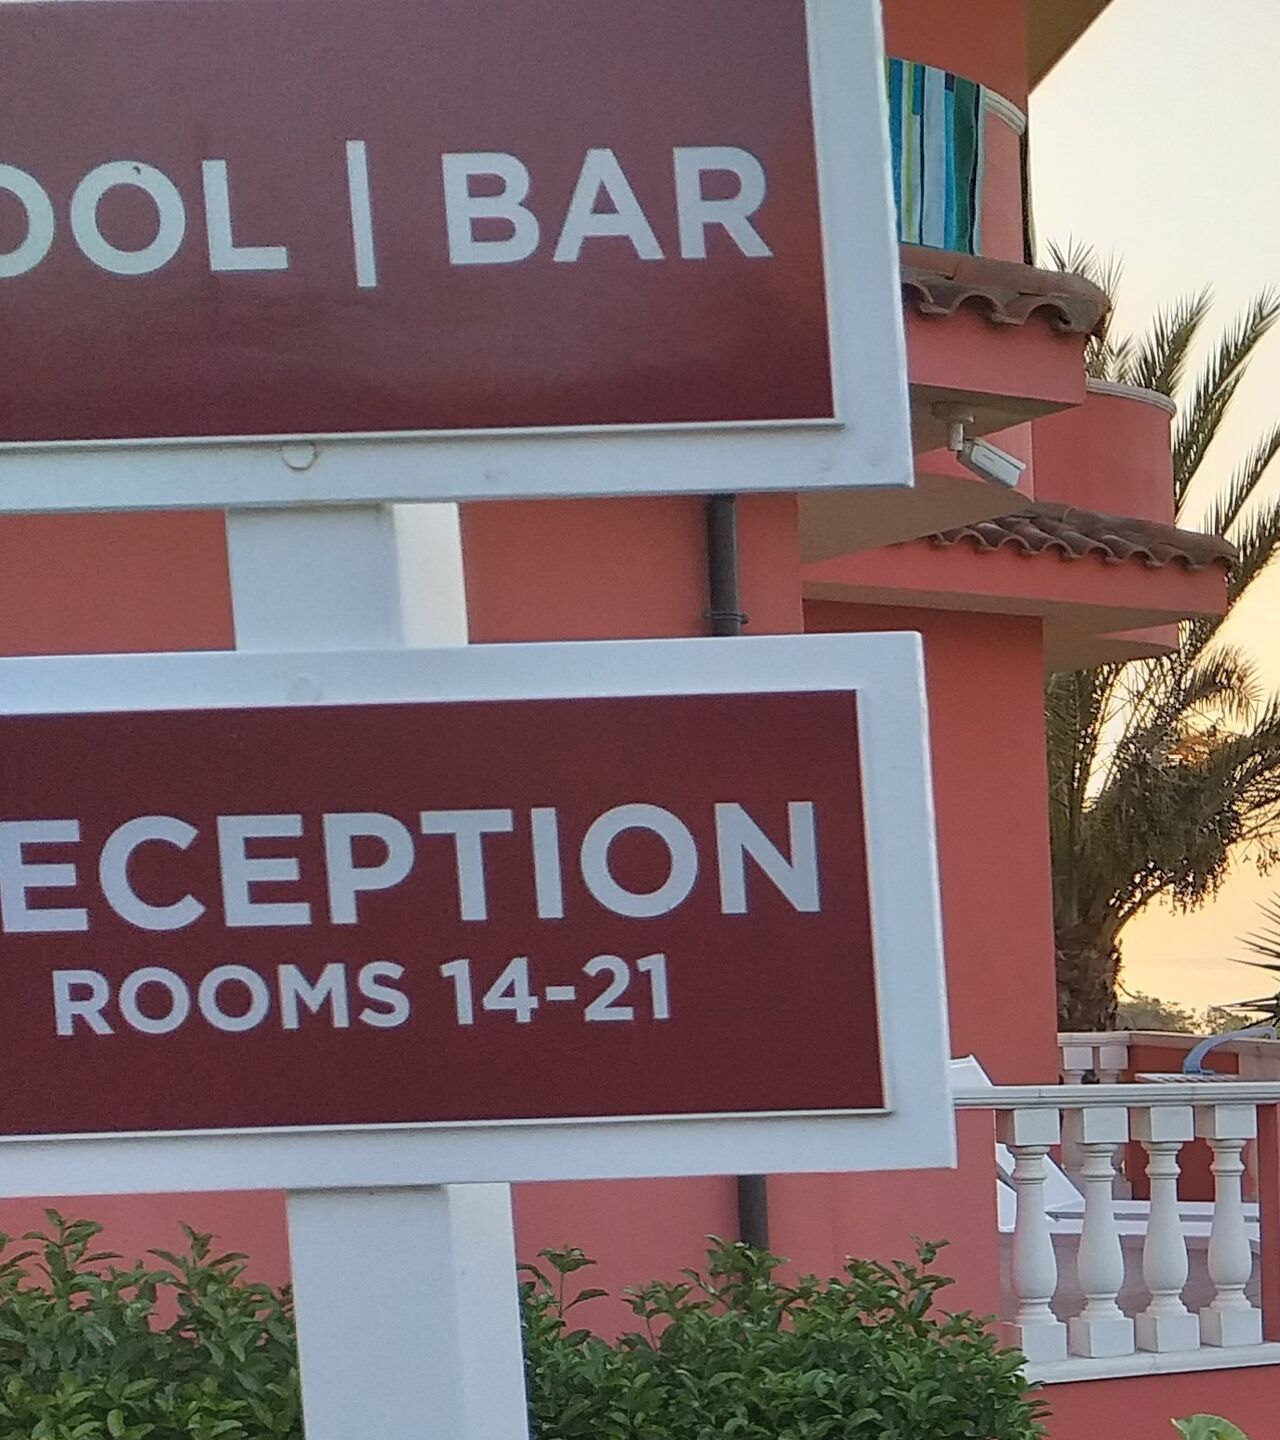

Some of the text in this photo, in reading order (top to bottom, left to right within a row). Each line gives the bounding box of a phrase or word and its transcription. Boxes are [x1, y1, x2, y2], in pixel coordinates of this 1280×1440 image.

[440, 144, 775, 267] BAR
[0, 800, 822, 934] ECEPTION
[51, 952, 671, 1037] ROOMS 14-21
